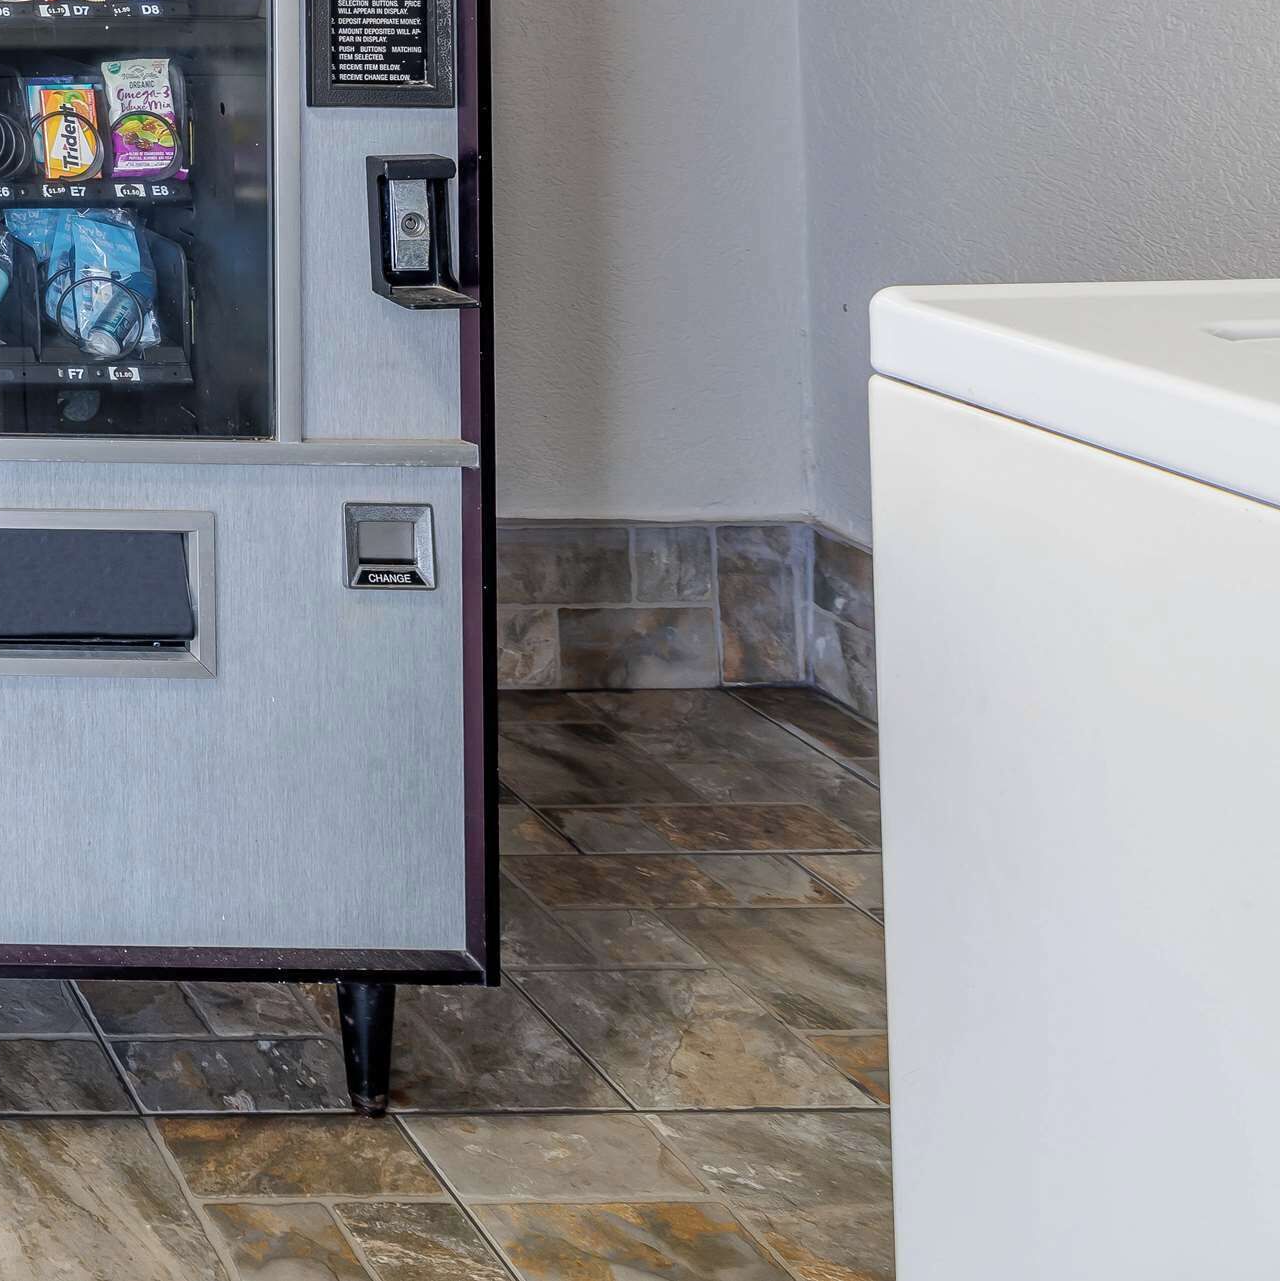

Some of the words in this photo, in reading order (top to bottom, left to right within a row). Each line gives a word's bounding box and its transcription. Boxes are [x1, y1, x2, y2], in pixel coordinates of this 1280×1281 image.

[73, 6, 89, 15] D7
[142, 5, 160, 15] D8
[129, 80, 155, 89] ORGANIC
[117, 86, 170, 104] Omega-3
[147, 100, 171, 112] Mix
[59, 103, 79, 170] Trident
[70, 187, 86, 196] E7
[152, 186, 169, 195] E8
[68, 369, 84, 379] F7
[368, 573, 412, 583] CHANGE
